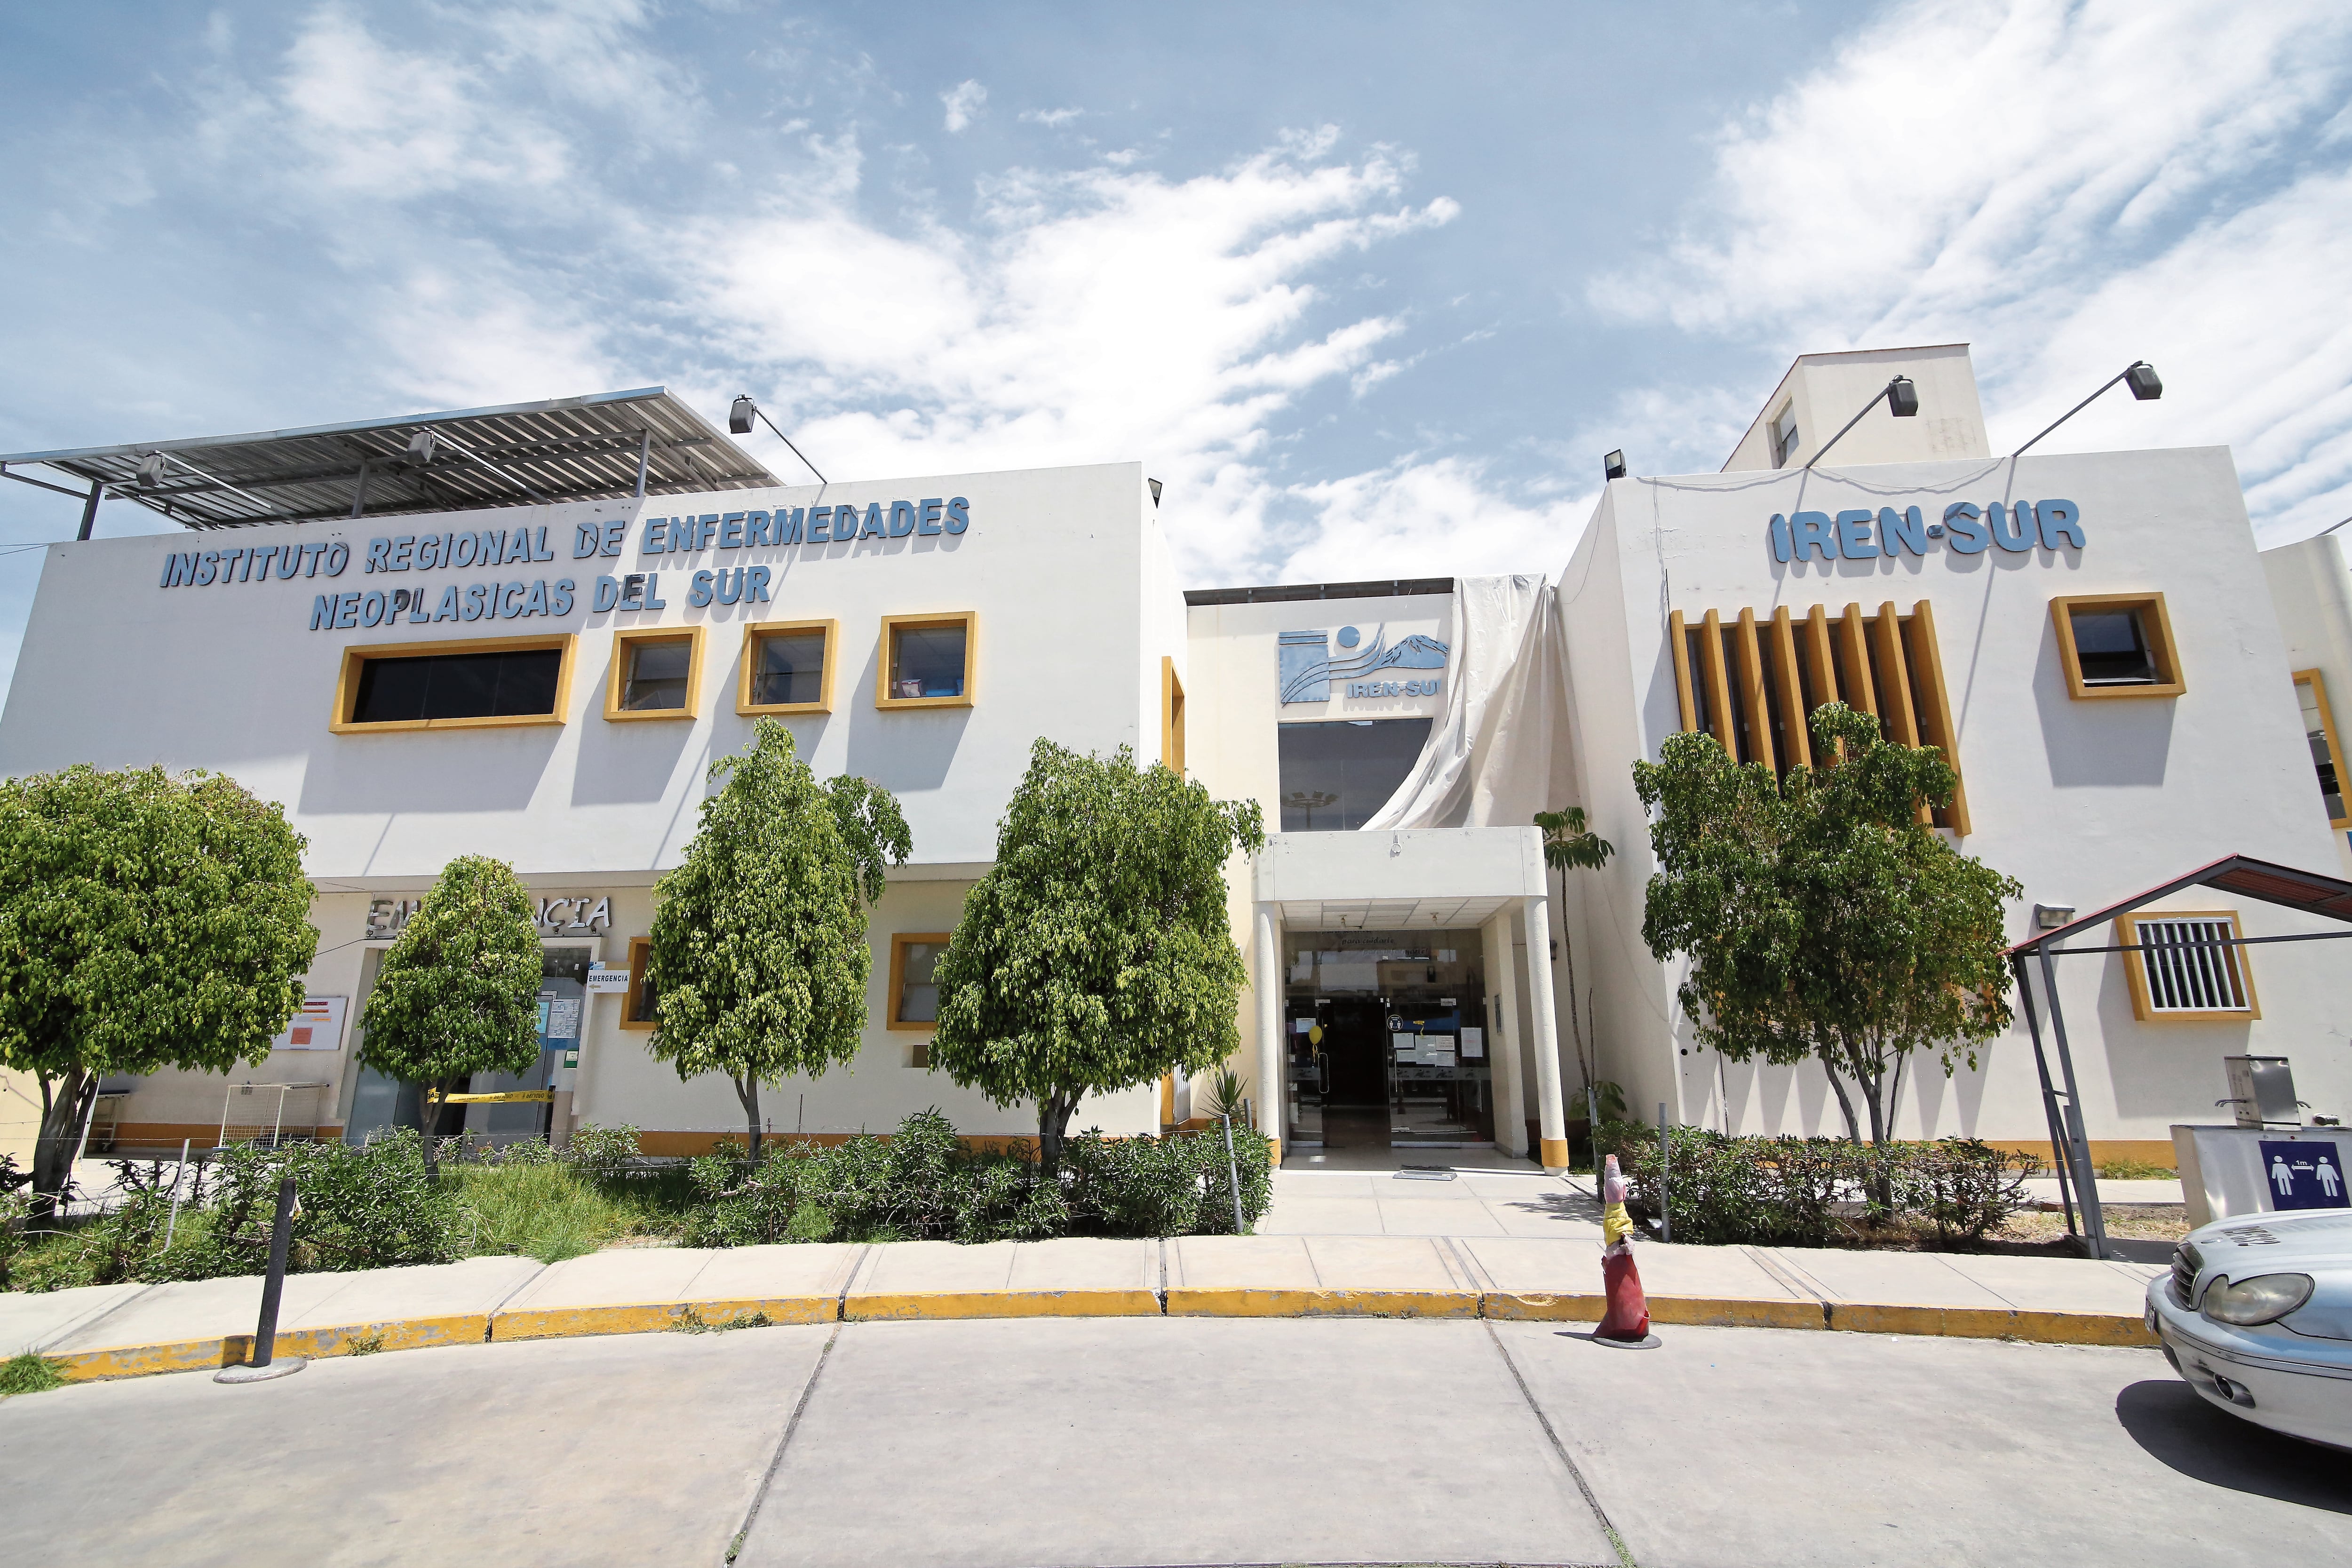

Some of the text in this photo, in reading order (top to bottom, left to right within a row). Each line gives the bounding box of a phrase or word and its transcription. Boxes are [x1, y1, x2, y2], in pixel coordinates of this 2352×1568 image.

[160, 496, 969, 588] INSTITUTO REGIONAL DE ENFERMEDADES
[310, 565, 770, 630] NEOPLASICAS DEL SUR
